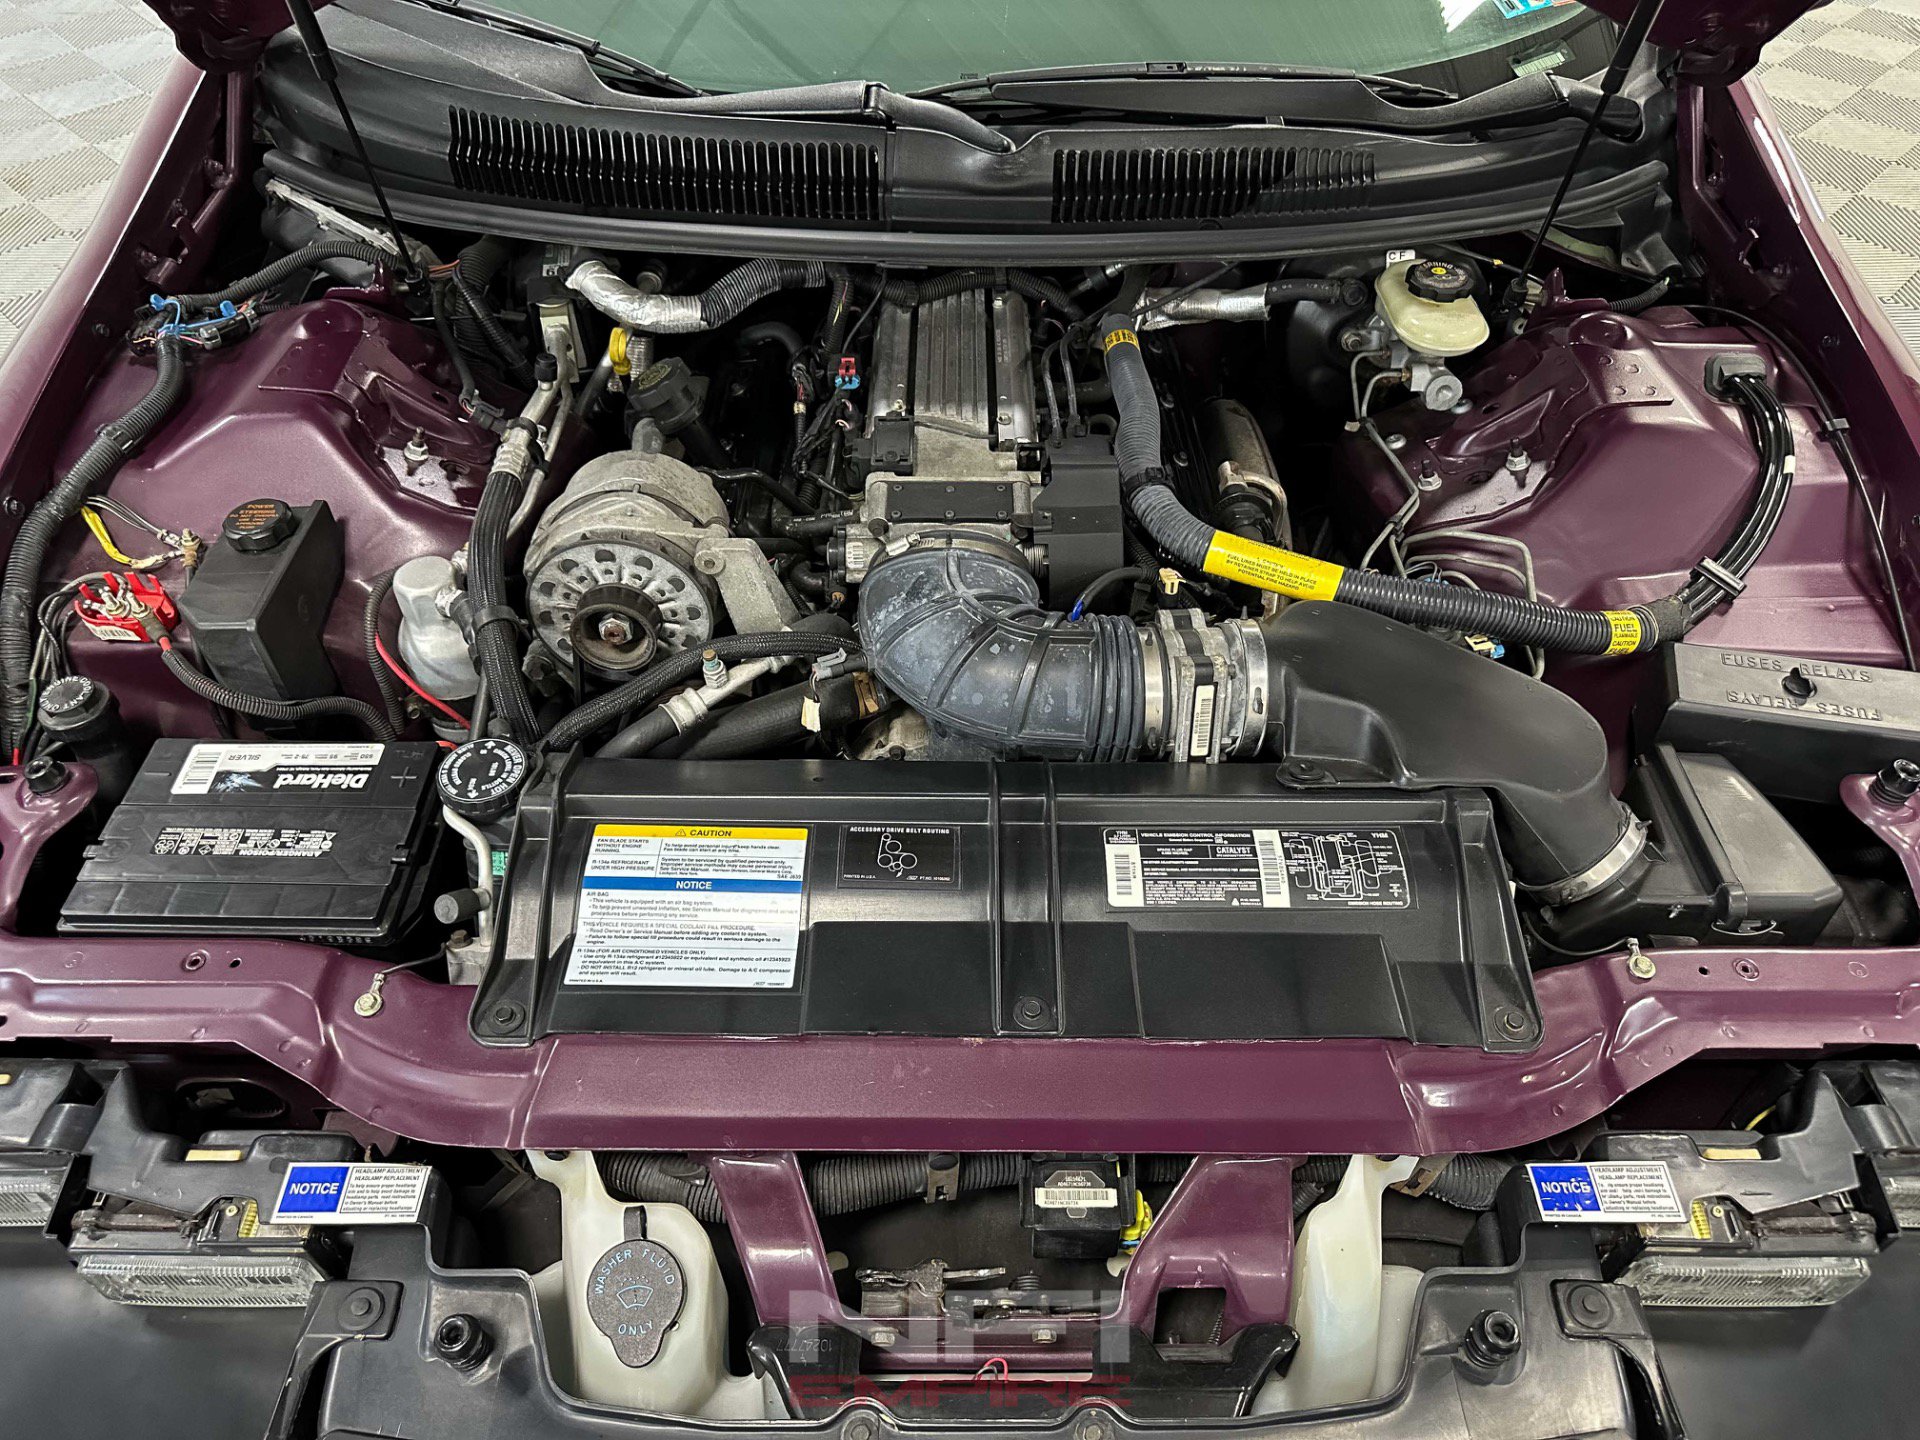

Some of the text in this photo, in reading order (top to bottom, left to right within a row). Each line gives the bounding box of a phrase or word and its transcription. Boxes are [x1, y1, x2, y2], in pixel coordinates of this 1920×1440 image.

[1388, 252, 1396, 260] C
[1228, 554, 1240, 562] FUEL
[1256, 561, 1271, 570] MUST
[1300, 575, 1317, 585] PLACE
[1238, 569, 1265, 581] POTENTIAL
[1260, 570, 1276, 578] STRAP
[1285, 577, 1298, 585] HELP
[1614, 624, 1635, 632] FUEL
[1721, 653, 1872, 683] FUSES RELAYS
[1727, 690, 1884, 721] FUSES RELAYS
[490, 745, 523, 796] NEVER OPEN HOT
[273, 774, 369, 790] DieHard
[676, 881, 713, 890] NOTICE
[289, 1183, 340, 1195] NOTICE
[1541, 1182, 1592, 1195] NOTICE
[595, 1249, 675, 1295] WASHER FLUID
[618, 1321, 653, 1335] ONLY
